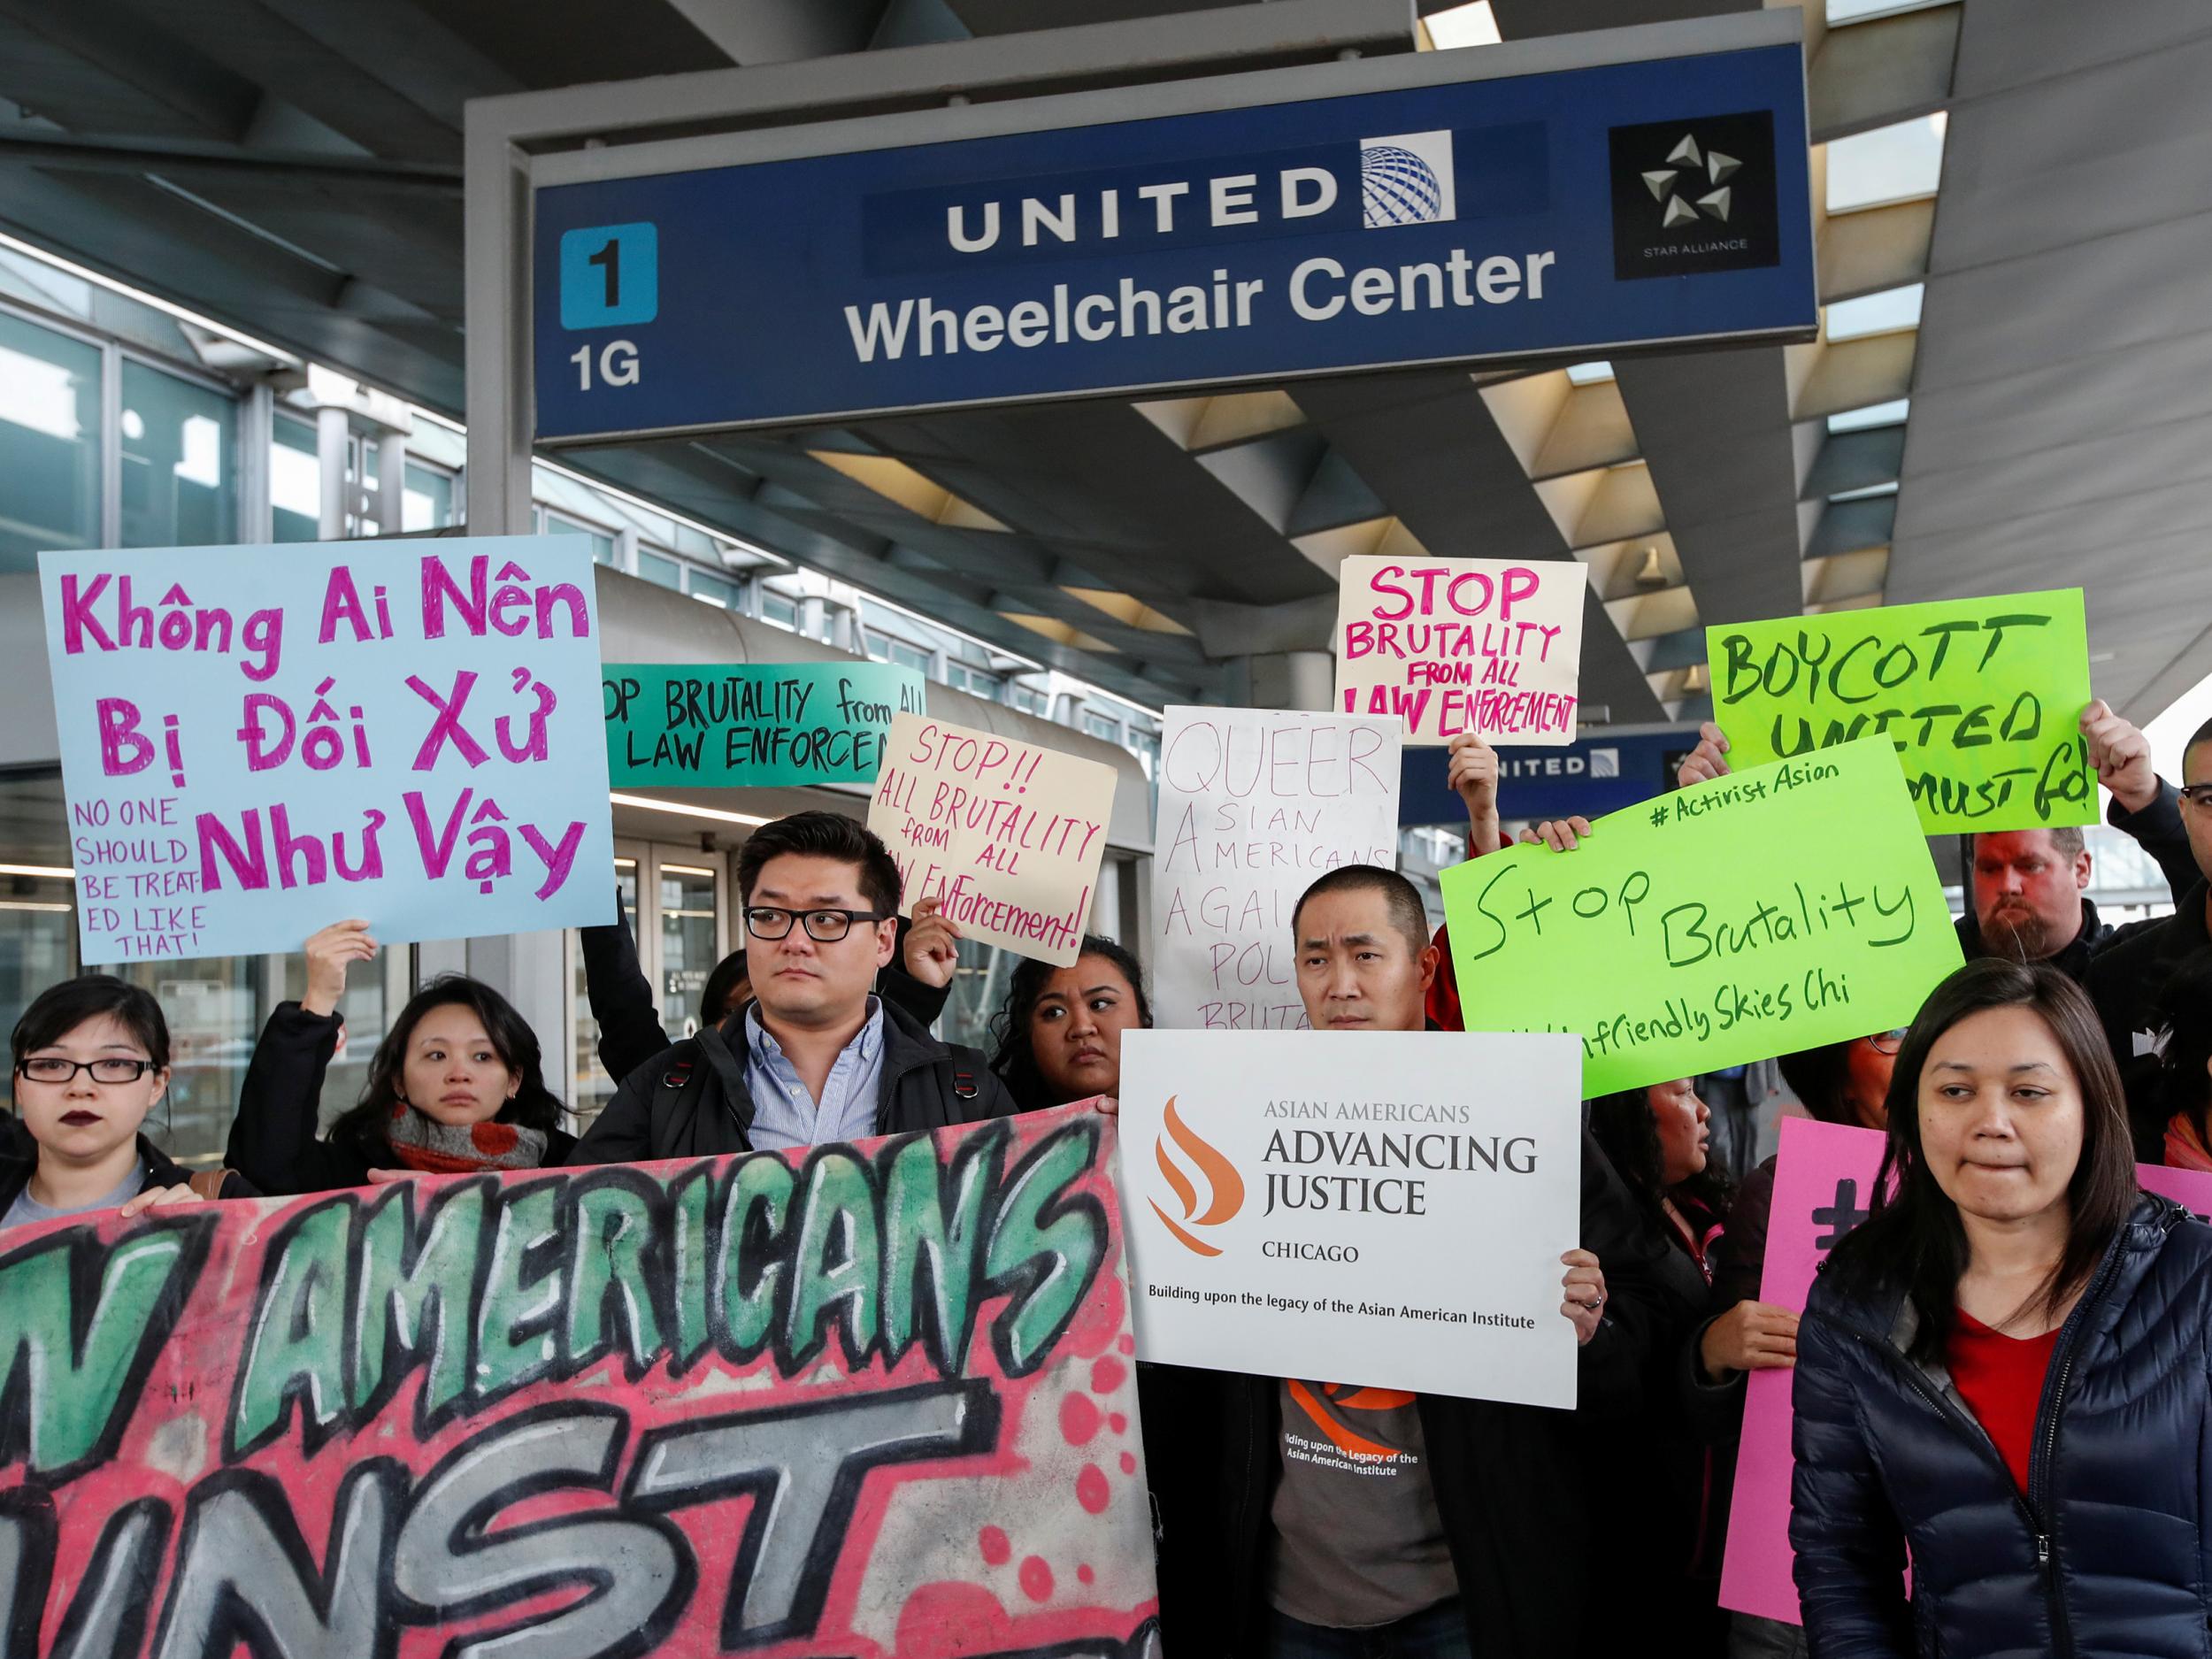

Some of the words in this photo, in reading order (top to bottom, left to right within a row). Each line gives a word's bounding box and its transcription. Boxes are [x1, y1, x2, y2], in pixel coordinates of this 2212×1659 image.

[947, 166, 1338, 253] UNITED
[1644, 246, 1678, 258] STAR
[1682, 239, 1748, 255] ALLIANCE
[588, 238, 620, 308] 1
[843, 269, 1263, 363] Wheelchair
[1288, 249, 1555, 321] Center
[570, 339, 641, 391] 1G
[1371, 566, 1540, 621] STOP
[60, 572, 284, 682] Không
[319, 565, 394, 644] Ai
[421, 555, 590, 640] Nên
[1346, 621, 1562, 663] BRUTALITY
[1407, 660, 1473, 687] FROM
[1480, 657, 1521, 687] ALL
[1722, 614, 2052, 704] BOYCOTT
[96, 697, 187, 788] Bị
[236, 676, 373, 772] Đối
[404, 666, 557, 772] Xử
[603, 678, 641, 725] OP
[665, 678, 814, 730] BRUTALITY
[836, 678, 892, 726] from
[1439, 688, 1578, 736] ENFORCEMENT
[626, 730, 705, 772] LAW
[910, 726, 1042, 794] STOP!!
[1165, 721, 1388, 797] QUEER
[1498, 757, 1586, 778] NITED
[74, 799, 110, 827] NO
[119, 797, 179, 826] ONE
[877, 767, 917, 814] ALL
[929, 781, 1101, 862] BRUTALITY
[75, 837, 188, 865] SHOULD
[195, 803, 387, 893] Như
[402, 787, 588, 902] Vậy
[974, 843, 1018, 875] ALL
[81, 875, 119, 899] BE
[88, 908, 120, 932] ED
[134, 905, 207, 932] LIKE
[1165, 887, 1300, 936] AGAI
[1660, 880, 1916, 968] Brutality
[114, 932, 200, 956] THAT!
[1263, 1100, 1328, 1119] ASIAN
[1335, 1102, 1471, 1125] AMERICANS
[1261, 1128, 1539, 1175] ADVANCING
[1262, 1173, 1427, 1217] JUSTICE
[1262, 1240, 1360, 1263] CHICAGO
[221, 1117, 1110, 1462] AMERICANS
[1148, 1284, 1200, 1303] Building
[1204, 1291, 1237, 1305] upon
[1240, 1291, 1263, 1306] the
[1267, 1294, 1309, 1313] legacy
[1313, 1298, 1328, 1311] of
[1331, 1299, 1354, 1314] the
[1358, 1302, 1395, 1317] Asian
[1400, 1305, 1467, 1324] American
[1472, 1310, 1535, 1330] Institute
[1287, 1448, 1310, 1462] Asian
[1311, 1454, 1353, 1471] American
[1354, 1463, 1397, 1477] Institute
[1310, 1440, 1334, 1454] upon
[1335, 1445, 1347, 1458] the
[1348, 1449, 1384, 1464] Legacy
[1386, 1453, 1399, 1463] of
[1400, 1454, 1418, 1464] the
